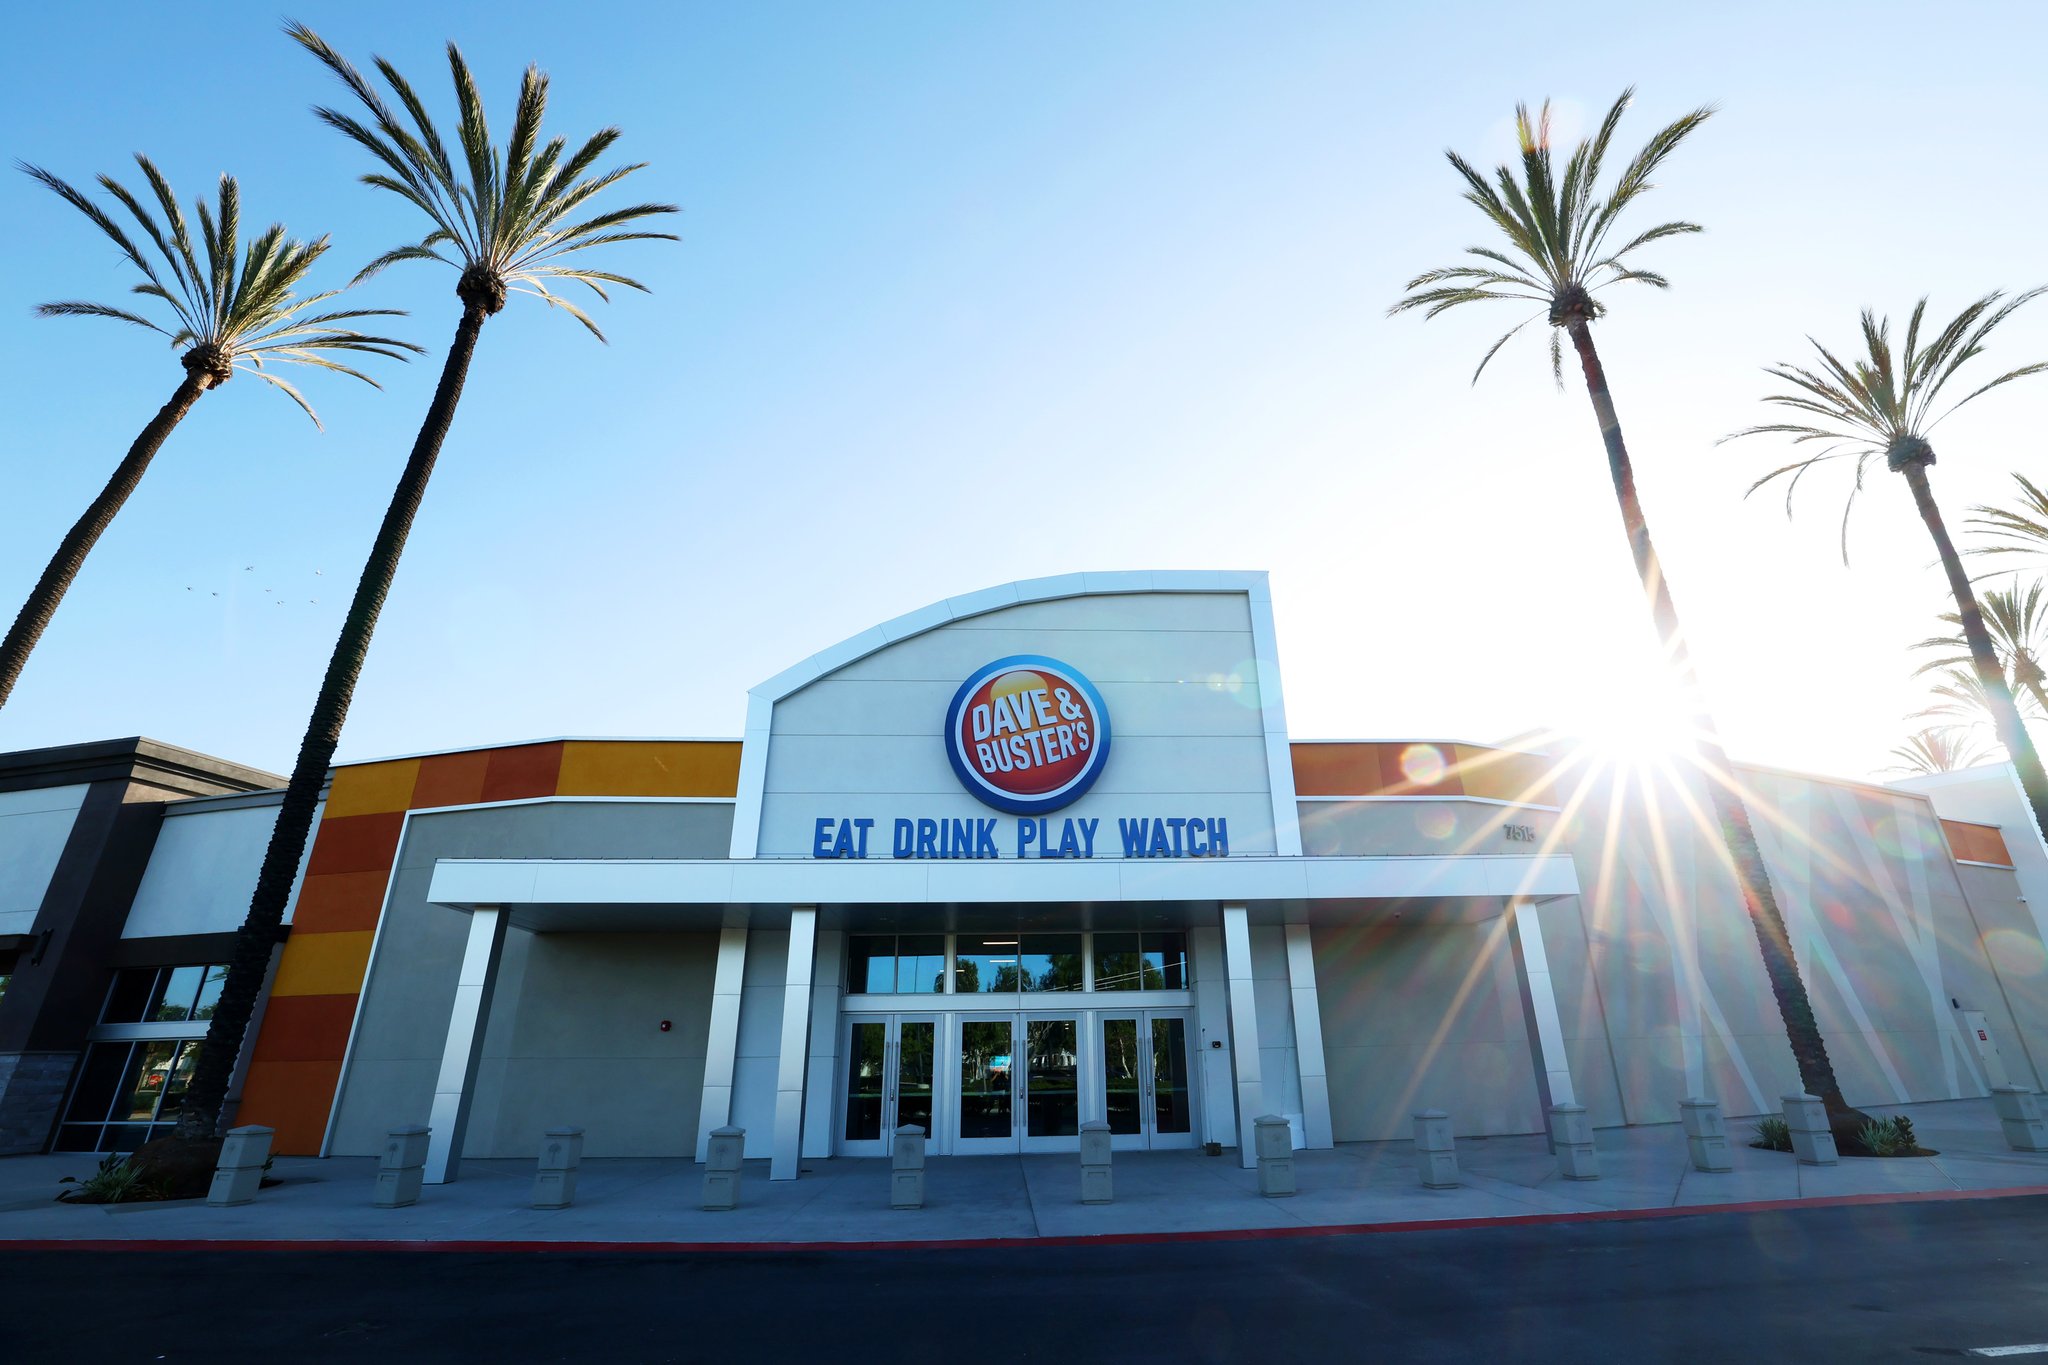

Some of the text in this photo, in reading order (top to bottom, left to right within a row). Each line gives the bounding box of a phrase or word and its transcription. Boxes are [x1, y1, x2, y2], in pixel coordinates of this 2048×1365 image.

[972, 687, 1085, 742] DAVE &
[976, 721, 1090, 774] BUSTER'S
[813, 817, 1229, 859] EAT DRINK PLAY WATCH
